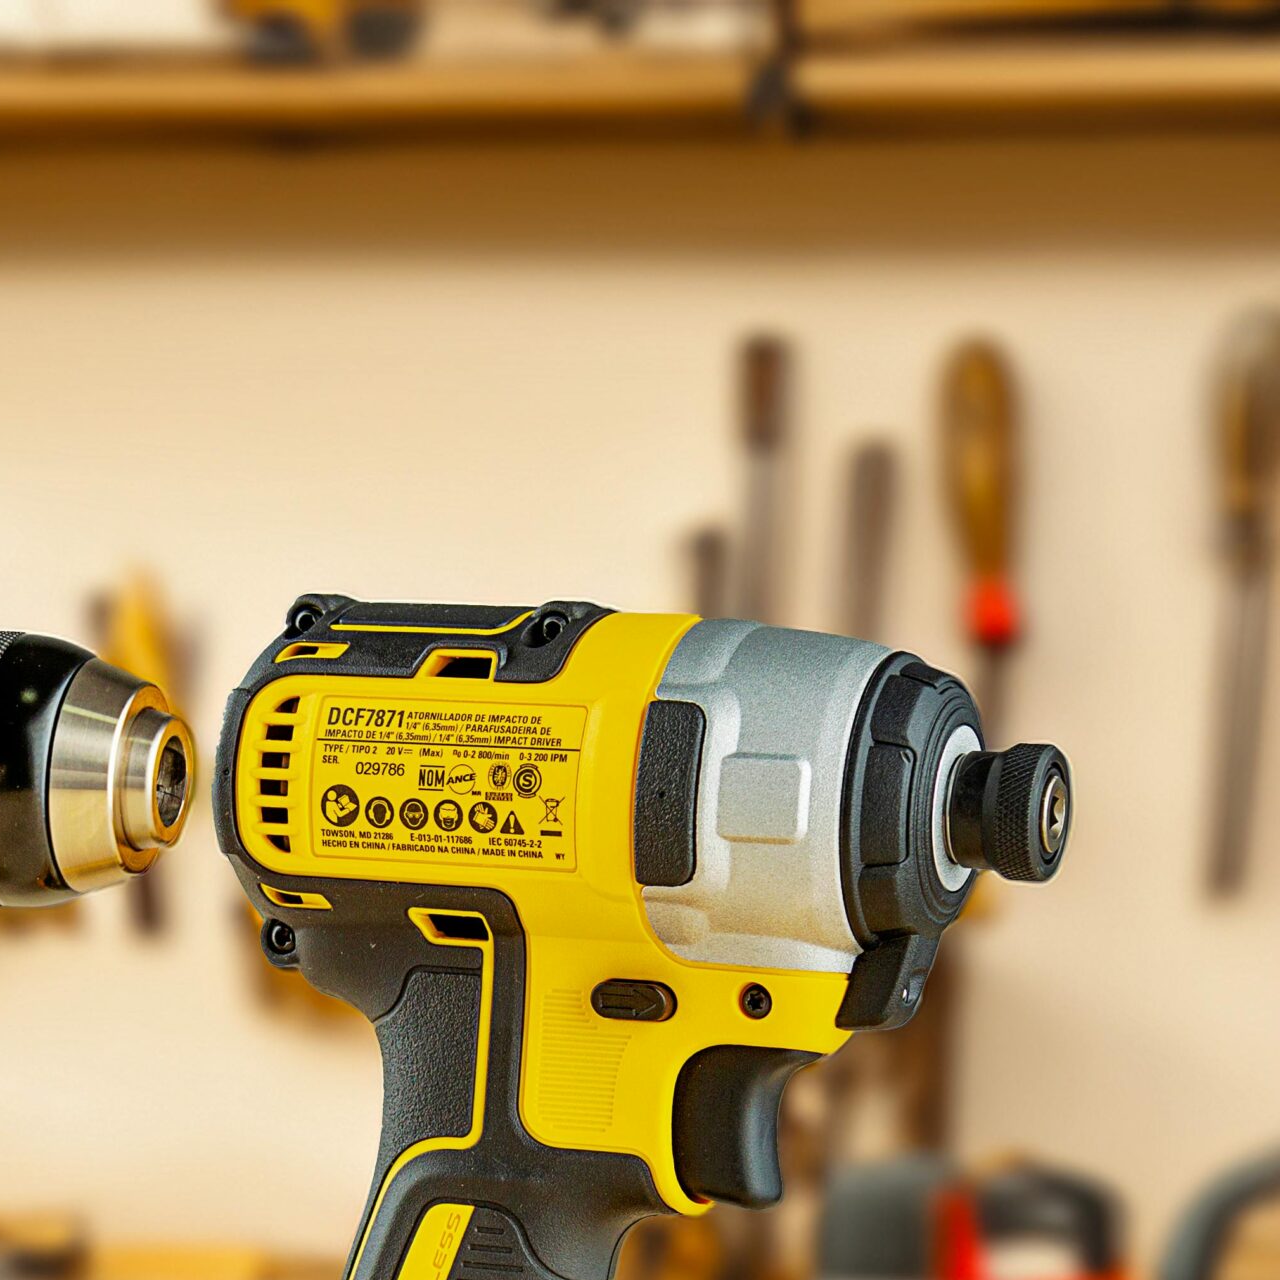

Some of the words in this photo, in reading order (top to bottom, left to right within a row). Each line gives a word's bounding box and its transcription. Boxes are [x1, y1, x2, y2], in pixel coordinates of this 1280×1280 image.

[327, 707, 405, 728] DCF7871
[407, 712, 472, 722] ATORNILLADOR
[475, 714, 486, 722] DE
[488, 715, 528, 724] IMPACTO
[530, 716, 542, 724] DE
[423, 722, 458, 732] (6,35mm)
[465, 724, 538, 735] PARAFUSADEIRA
[540, 727, 552, 735] DE
[325, 729, 363, 738] IMPACTO
[366, 730, 376, 739] DE
[396, 732, 431, 742] (6,35mm)
[456, 734, 492, 744] (6,35mm)
[494, 736, 528, 745] IMPACT
[530, 737, 562, 746] DRIVER
[322, 755, 339, 764] SER.
[324, 744, 344, 753] TYPE
[352, 745, 370, 754] TIPO
[372, 746, 377, 754] 2
[386, 747, 395, 755] 20
[420, 748, 443, 757] (Max)
[464, 750, 476, 759] 0-2
[478, 751, 510, 760] 800/min
[519, 753, 532, 761] 0-3
[534, 753, 548, 762] 200
[551, 754, 568, 762] IPM
[356, 762, 405, 776] 029786
[419, 769, 445, 787] NOM
[446, 773, 476, 785] ANCE
[360, 831, 371, 839] MD
[374, 832, 393, 840] 21286
[489, 837, 502, 846] IEC
[504, 838, 542, 848] 60745-2-2
[322, 840, 347, 848] HECHO
[362, 841, 386, 850] CHINA
[392, 843, 435, 852] FABRICADO
[451, 846, 476, 855] CHINA
[482, 848, 505, 856] MADE
[518, 850, 543, 859] CHINA
